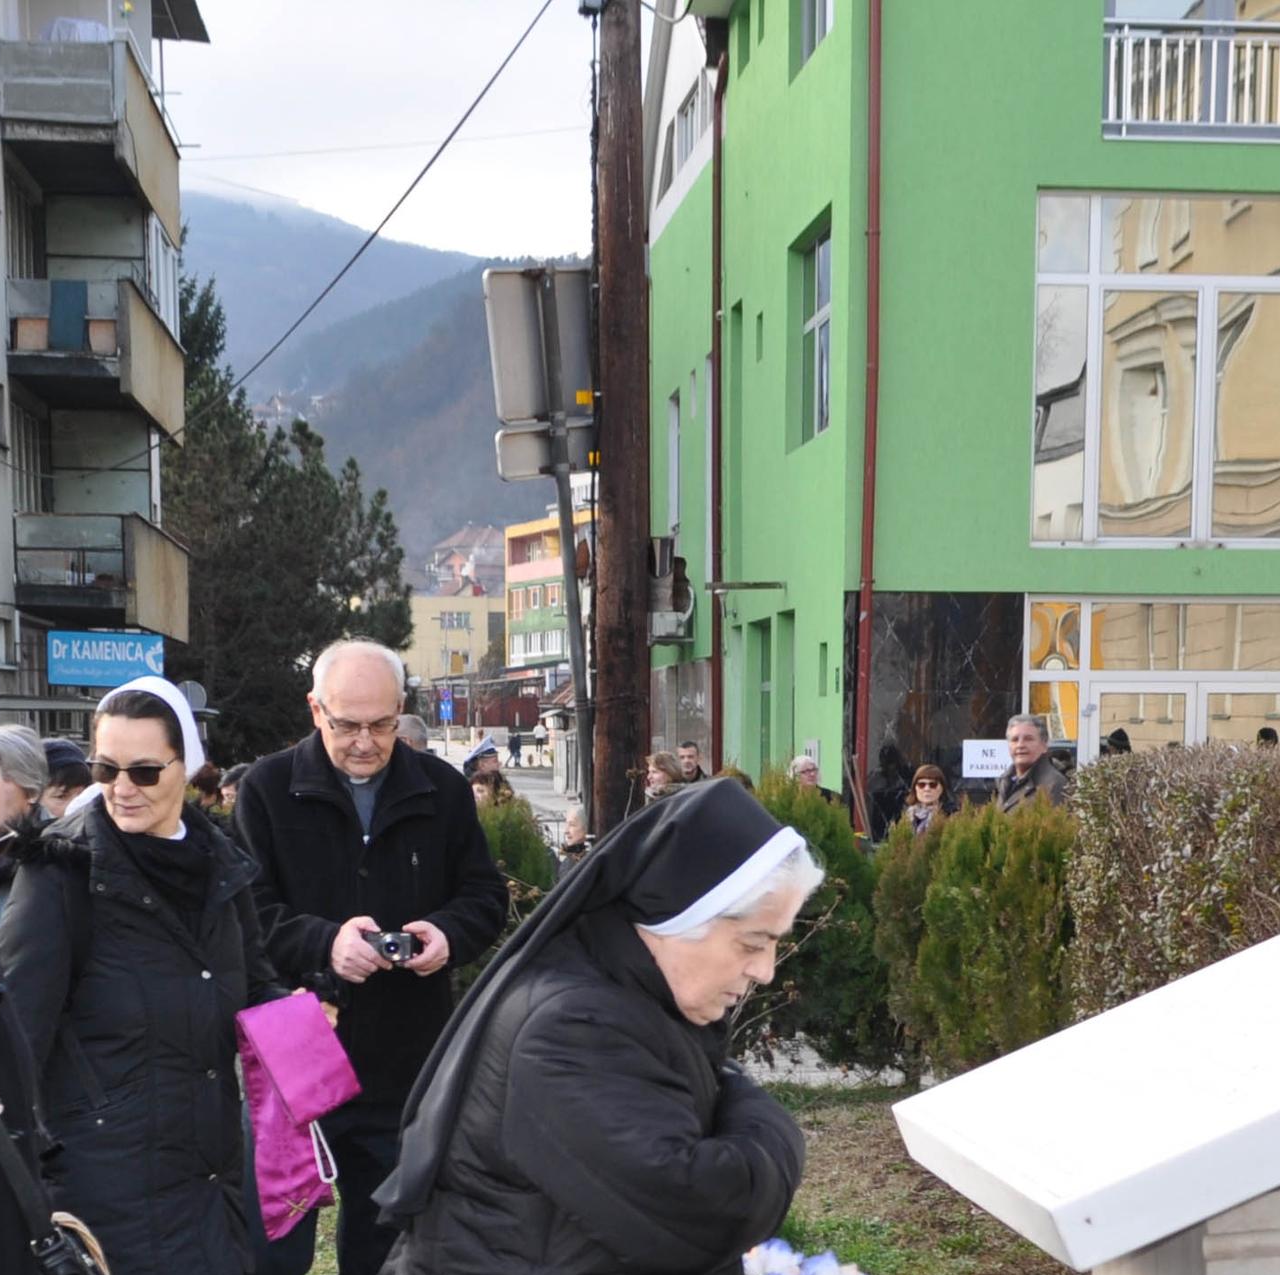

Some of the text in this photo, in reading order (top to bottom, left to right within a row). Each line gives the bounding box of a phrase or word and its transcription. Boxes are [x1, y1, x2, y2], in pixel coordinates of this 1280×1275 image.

[52, 639, 144, 661] Dr KAMENICA
[981, 748, 997, 758] NE
